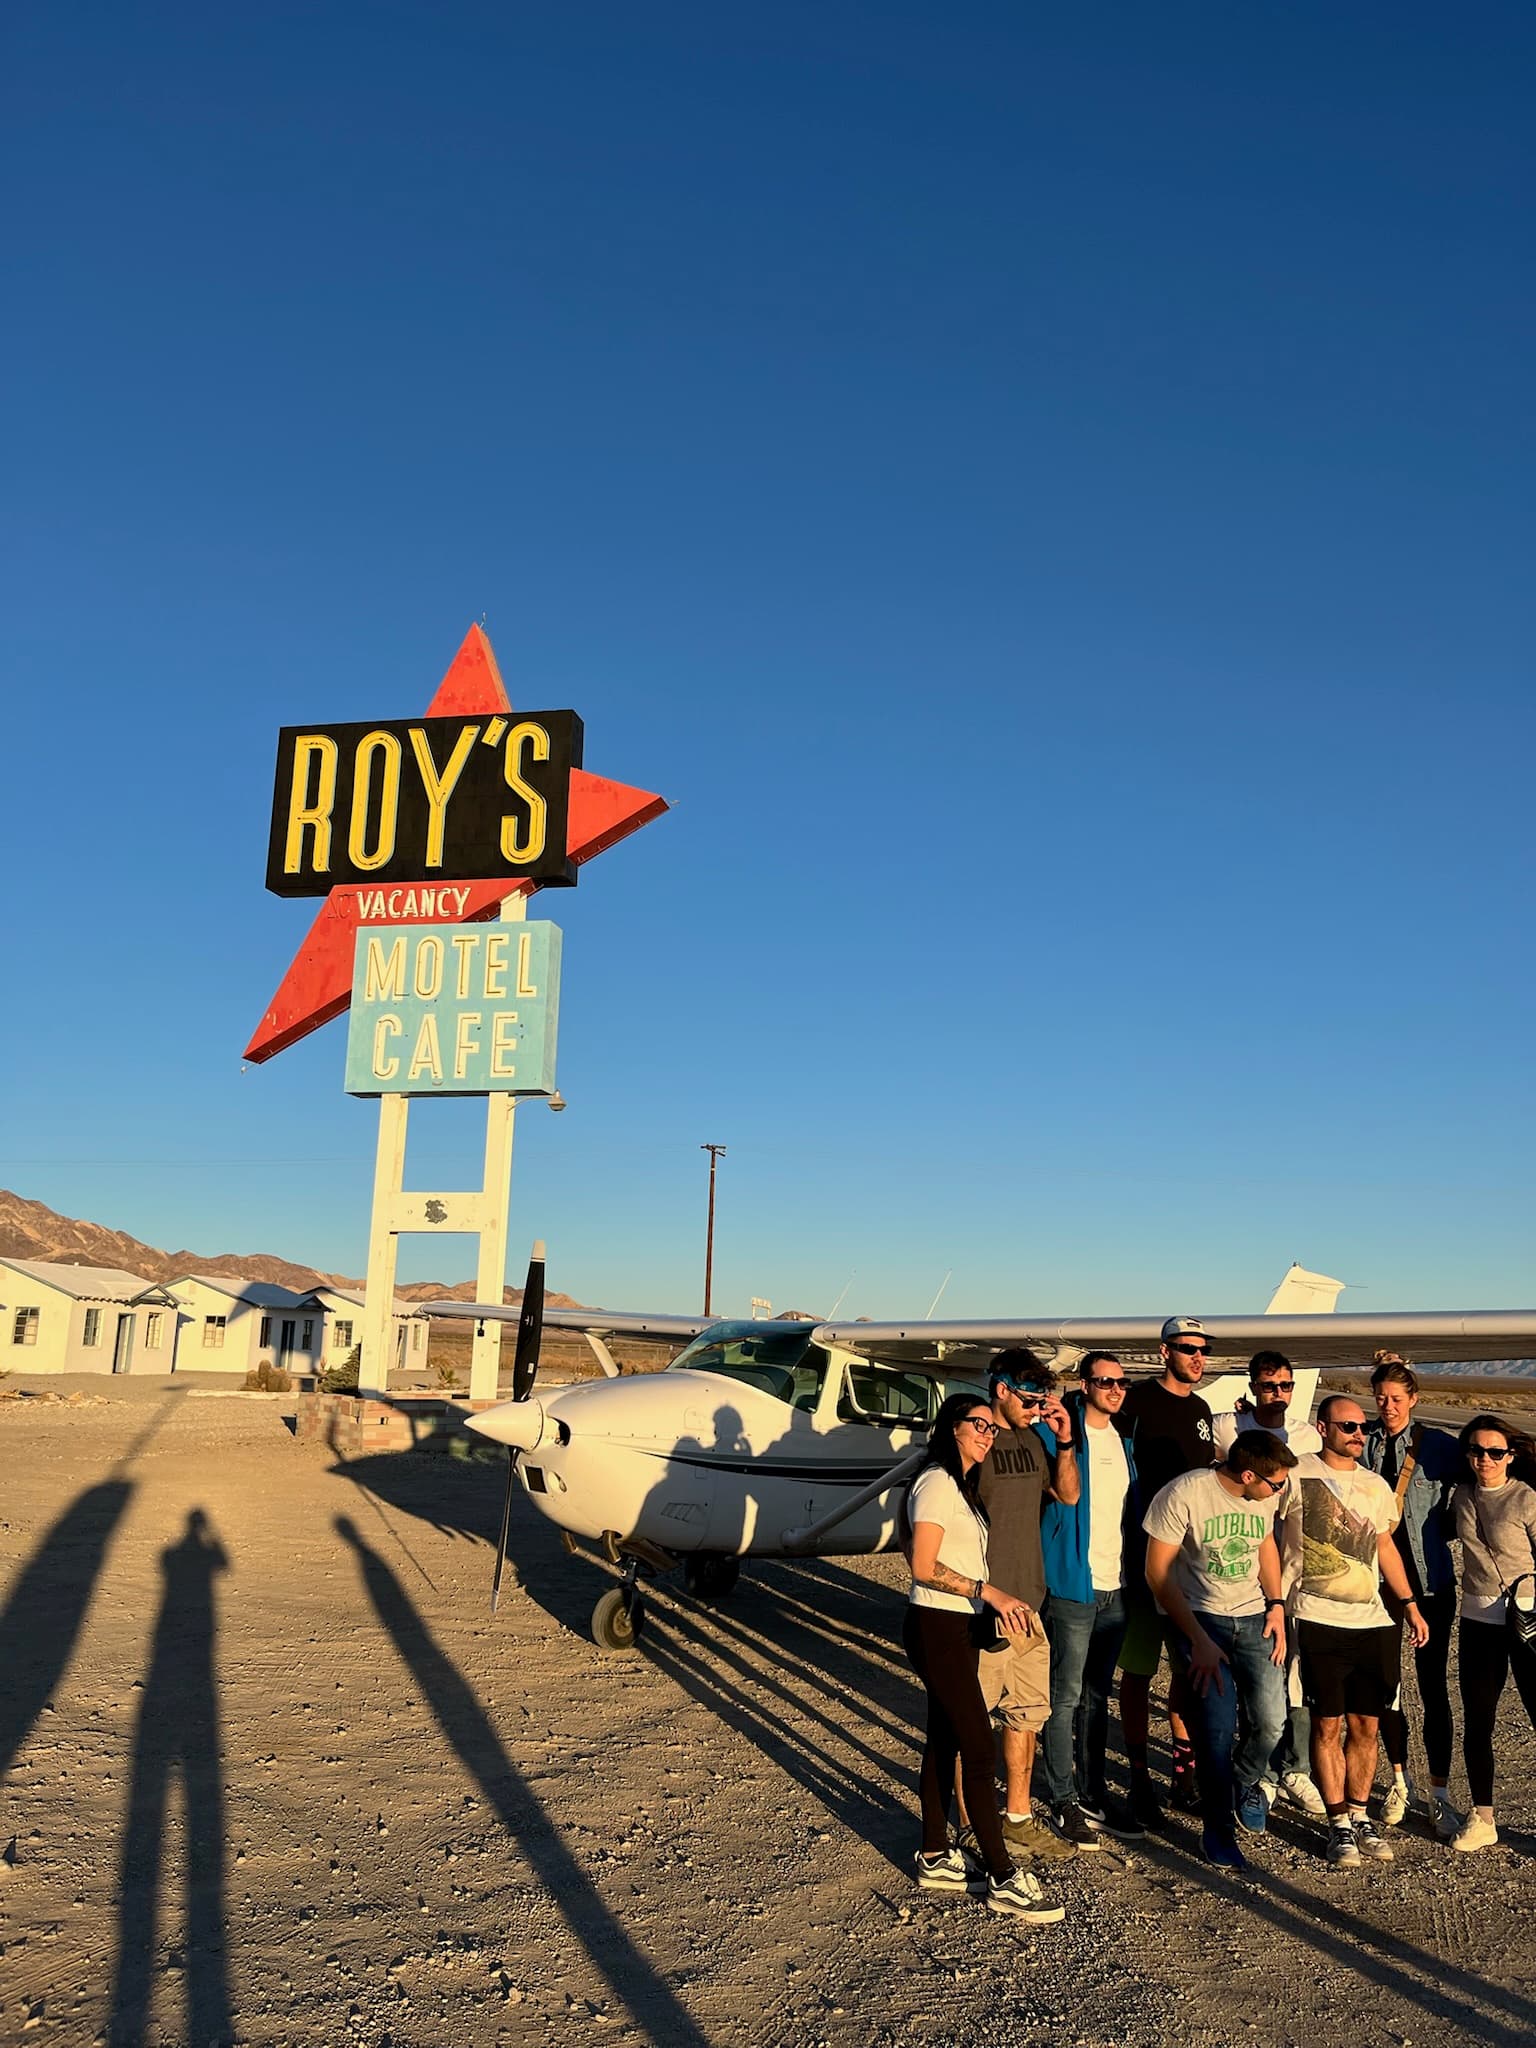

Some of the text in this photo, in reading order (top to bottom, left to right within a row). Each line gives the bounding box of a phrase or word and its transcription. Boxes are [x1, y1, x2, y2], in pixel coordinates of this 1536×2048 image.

[284, 715, 551, 874] ROY'S
[357, 887, 471, 919] VACANCY
[364, 932, 538, 1002] MOTEL
[372, 1012, 519, 1081] CAFE
[1202, 1512, 1265, 1544] DUBLIN
